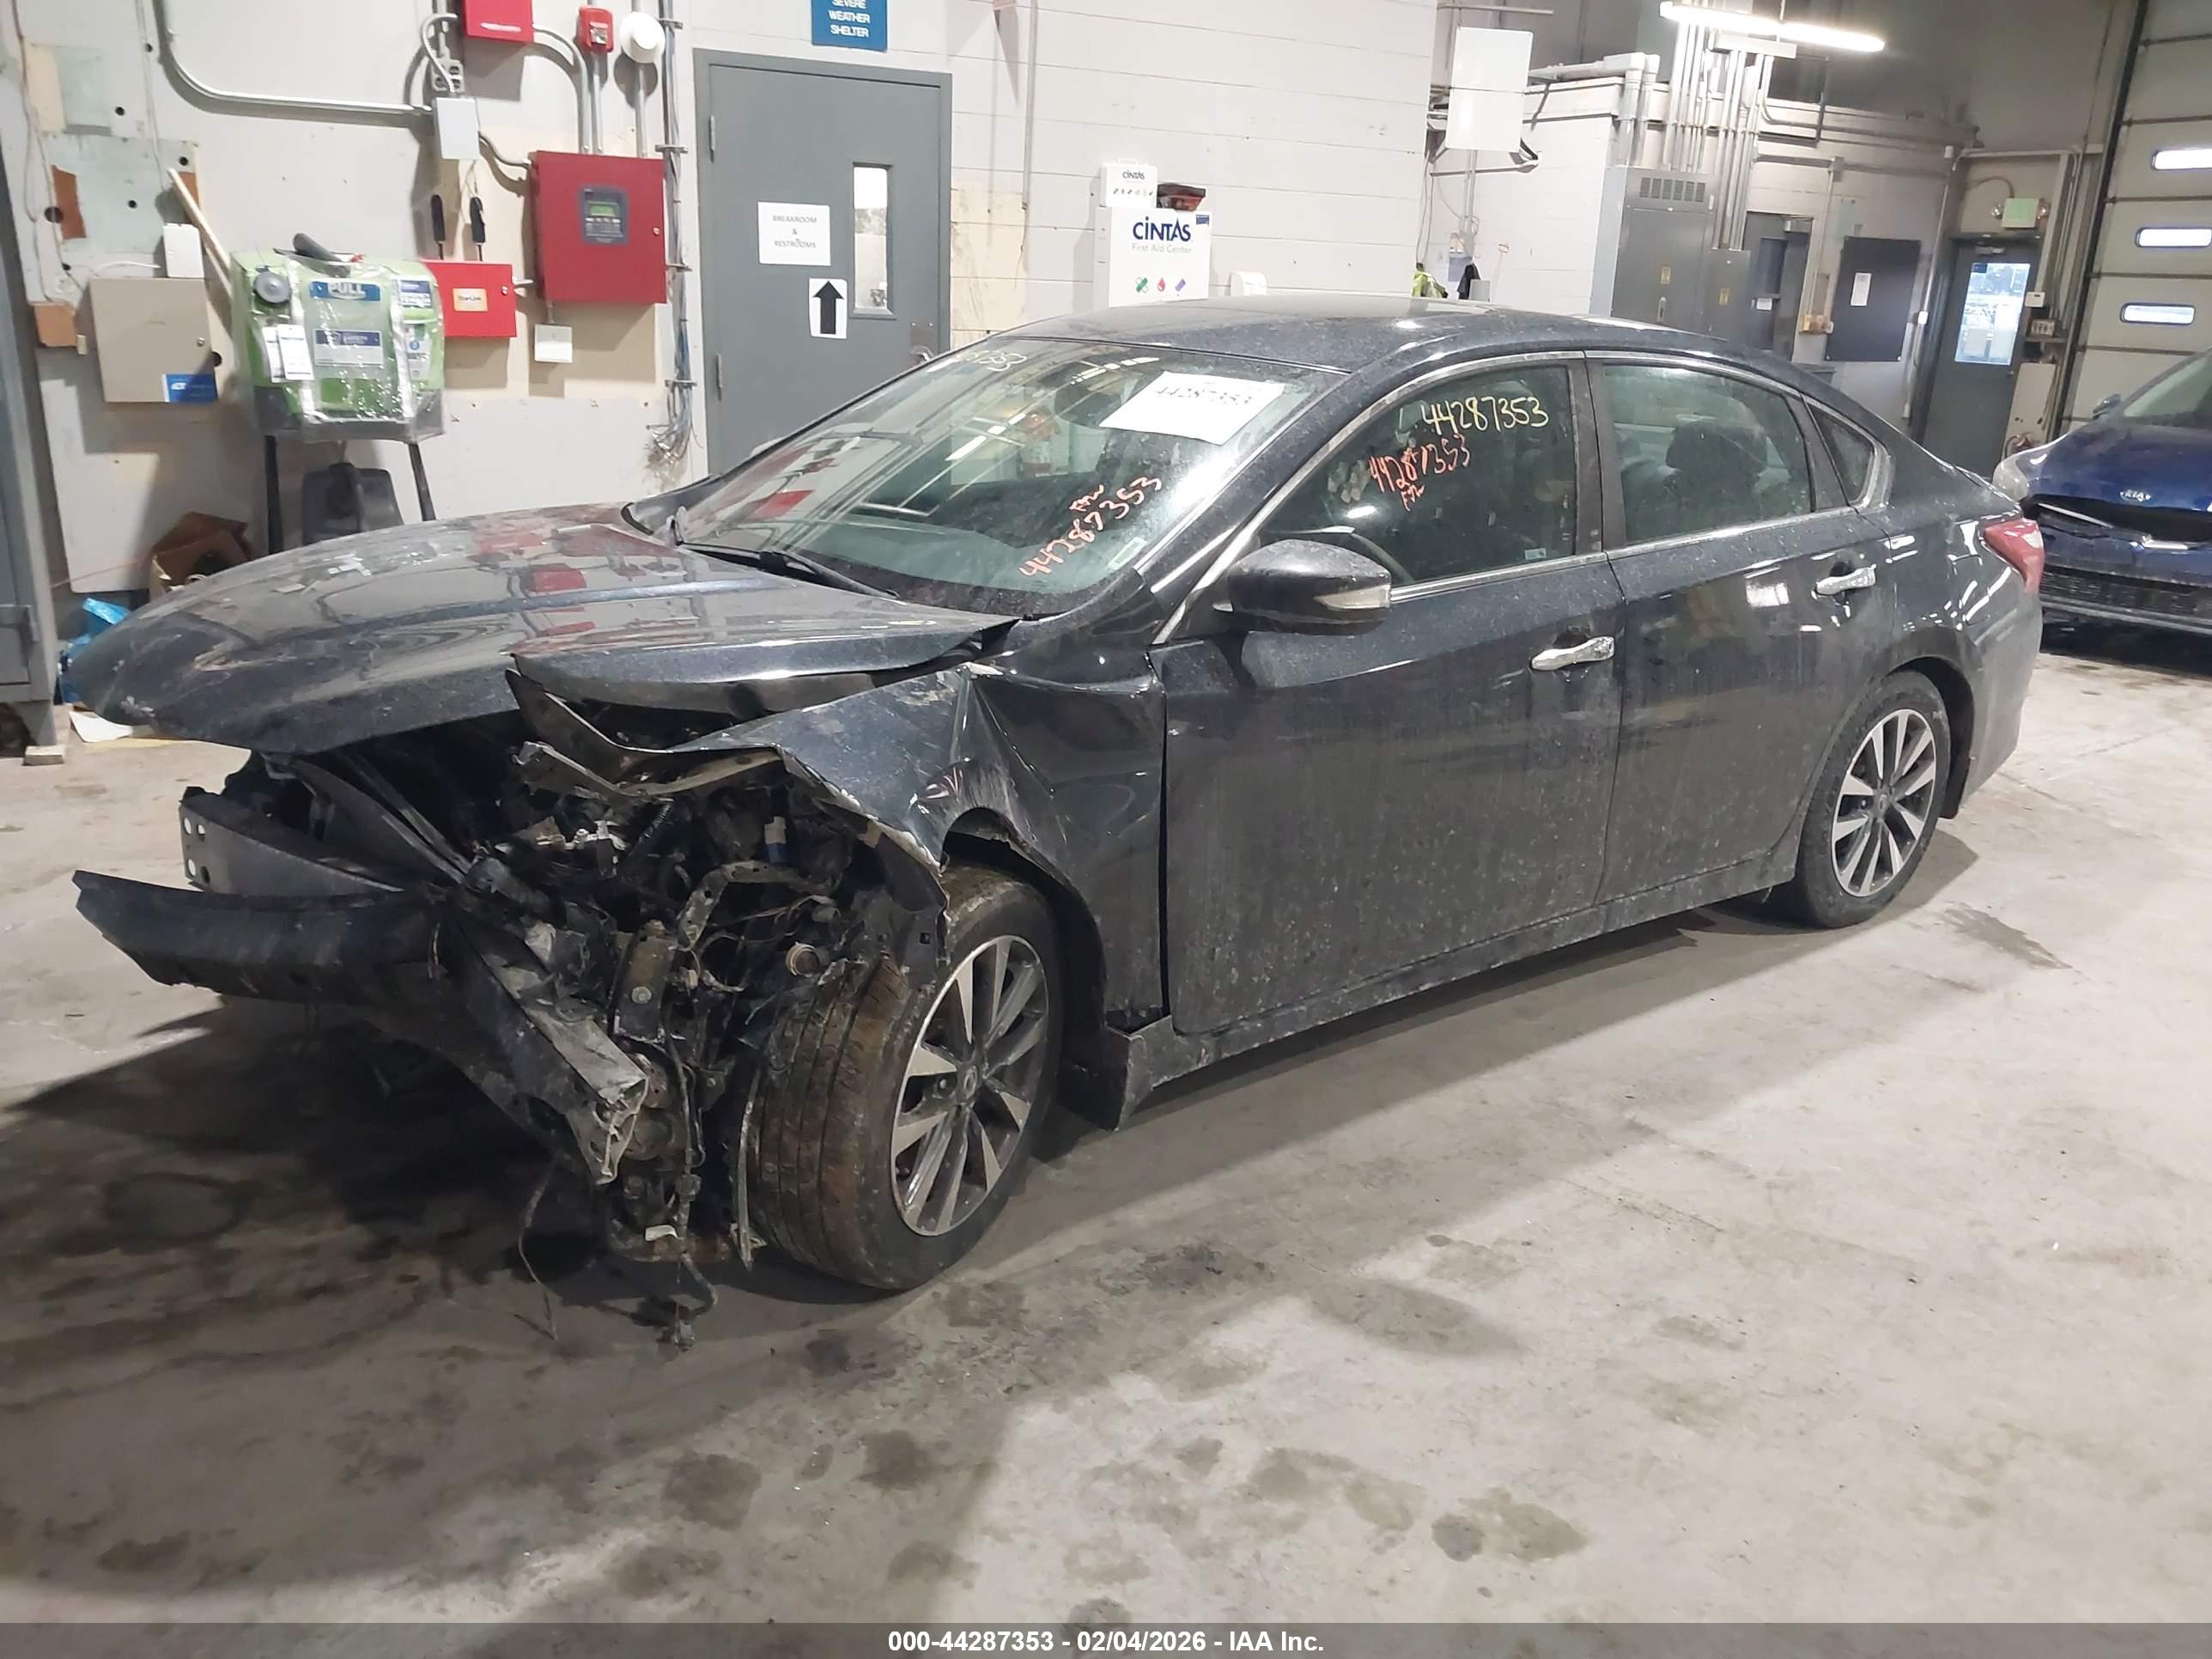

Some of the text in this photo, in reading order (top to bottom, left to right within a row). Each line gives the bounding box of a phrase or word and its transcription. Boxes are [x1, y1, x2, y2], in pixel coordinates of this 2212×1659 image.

[828, 9, 871, 24] WEATHER
[830, 24, 869, 38] SHELTER
[772, 215, 817, 223] BREAKROOM
[774, 239, 817, 248] RESTROOMS
[1132, 243, 1192, 254] First Aid Center
[328, 281, 365, 294] PULL
[1421, 397, 1549, 435] 44287353
[1018, 477, 1162, 576] 44287353
